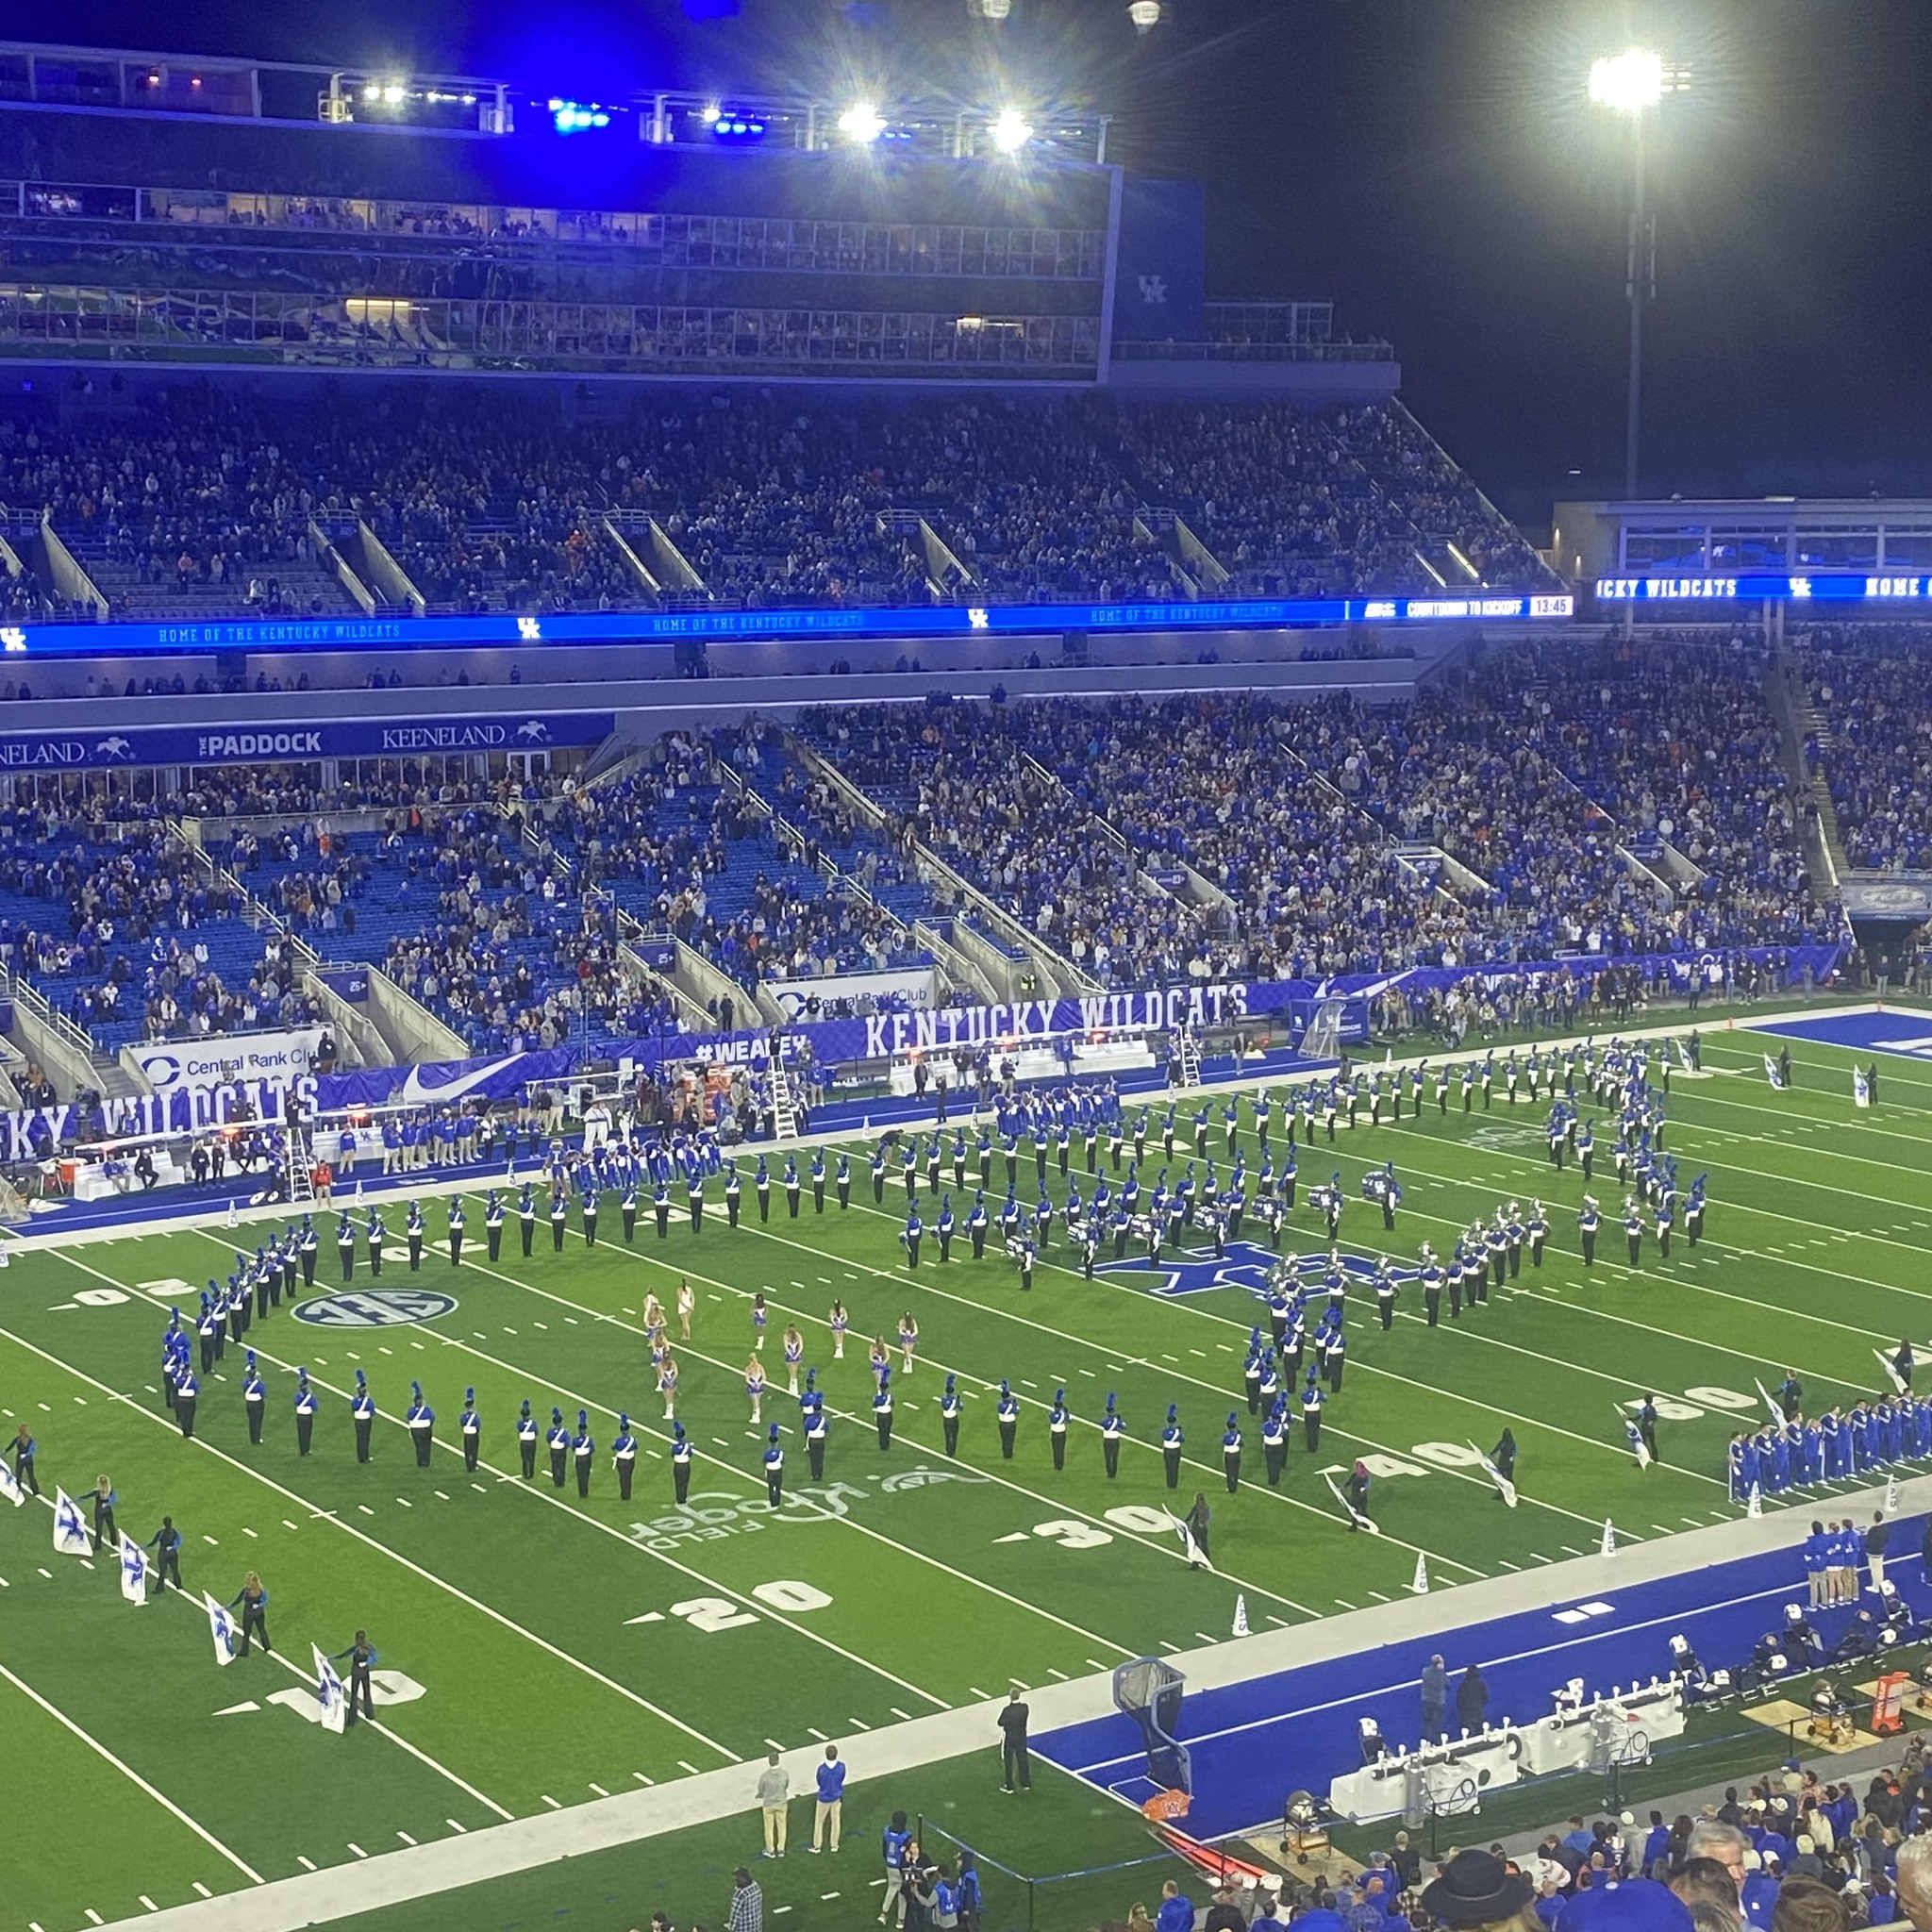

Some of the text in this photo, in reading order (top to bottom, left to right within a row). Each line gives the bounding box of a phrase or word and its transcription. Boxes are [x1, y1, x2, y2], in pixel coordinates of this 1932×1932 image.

[1138, 275, 1167, 303] UK
[1646, 579, 1736, 597] WILDCATS
[1865, 578, 1919, 596] HOME
[968, 608, 989, 628] UK
[1407, 601, 1467, 618] COUNTDOWN
[1469, 600, 1481, 616] TO
[1482, 600, 1523, 616] KICKOFF
[1537, 599, 1566, 613] 13:45
[159, 624, 400, 643] HOME OF THE KENTUCKY WILDCATS
[518, 618, 541, 640] UK
[654, 614, 863, 632] HOME OF THE KENTUCKY WILDCATS
[0, 627, 26, 652] UK
[199, 731, 322, 756] THE PADDOCK
[383, 724, 506, 748] KEENELAND
[897, 987, 927, 1003] Club
[866, 984, 1247, 1058] KENTUCKY WILDCATS
[291, 1048, 318, 1064] Clu
[101, 1076, 318, 1134] WILDCATS
[304, 1292, 445, 1325] SEC
[646, 1519, 765, 1549] FIELD
[1033, 1505, 1174, 1549] 30
[669, 1580, 833, 1632] 20
[1239, 1601, 1248, 1632] CATS
